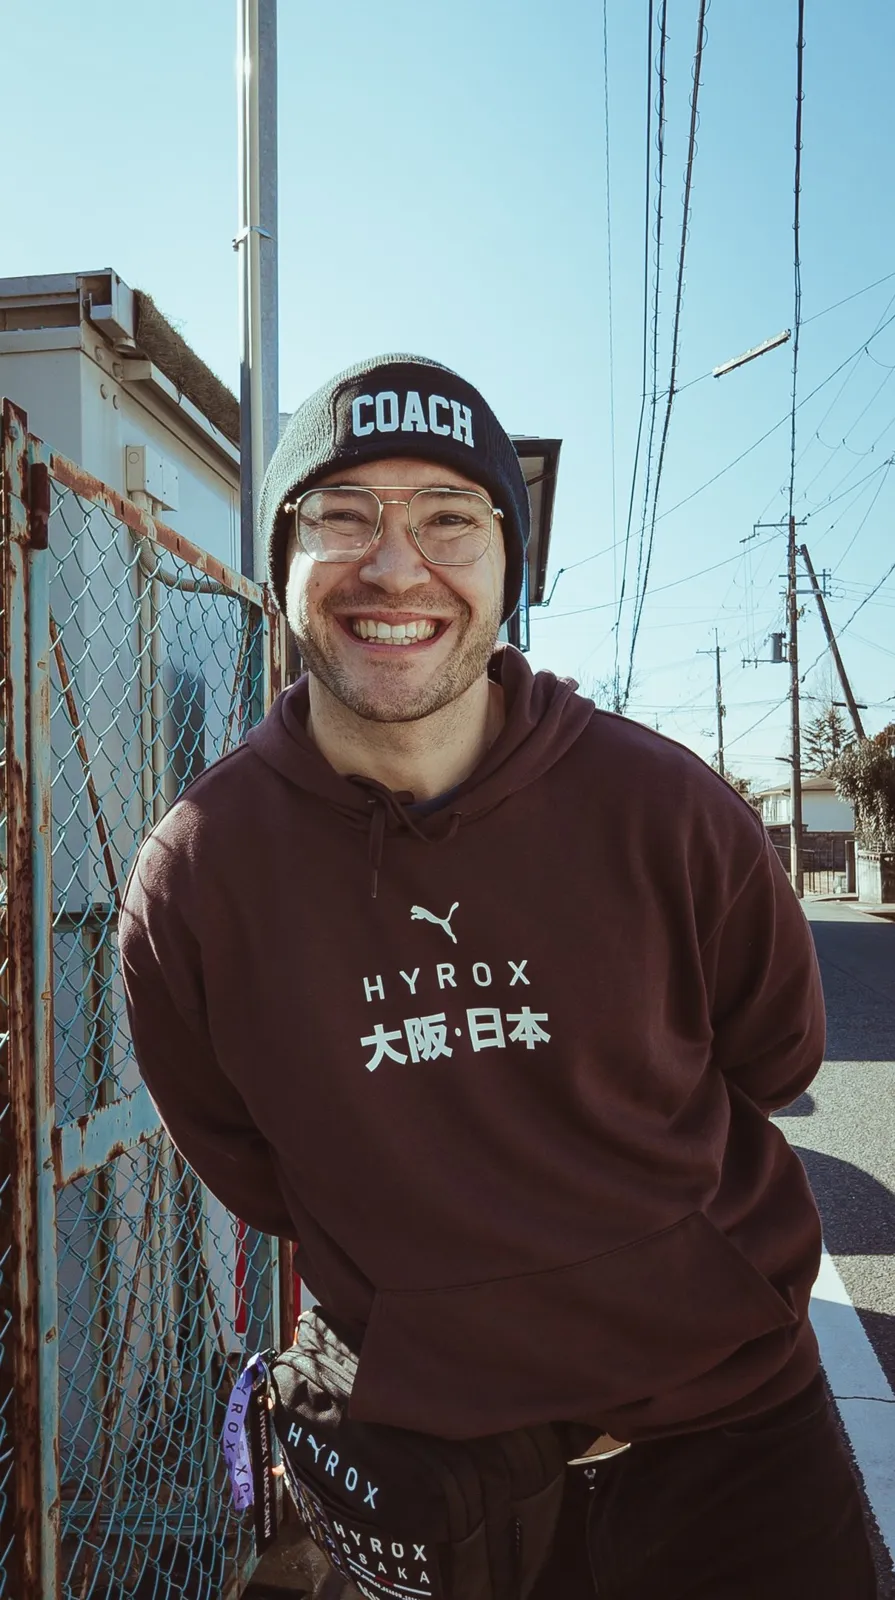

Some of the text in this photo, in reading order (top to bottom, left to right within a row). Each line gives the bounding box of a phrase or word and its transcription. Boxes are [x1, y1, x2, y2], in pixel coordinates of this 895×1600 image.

[352, 390, 475, 449] COACH
[363, 959, 531, 1002] HYROX
[287, 1422, 379, 1510] HYROX
[333, 1520, 427, 1562] HYROX
[342, 1542, 430, 1585] OSAKA
